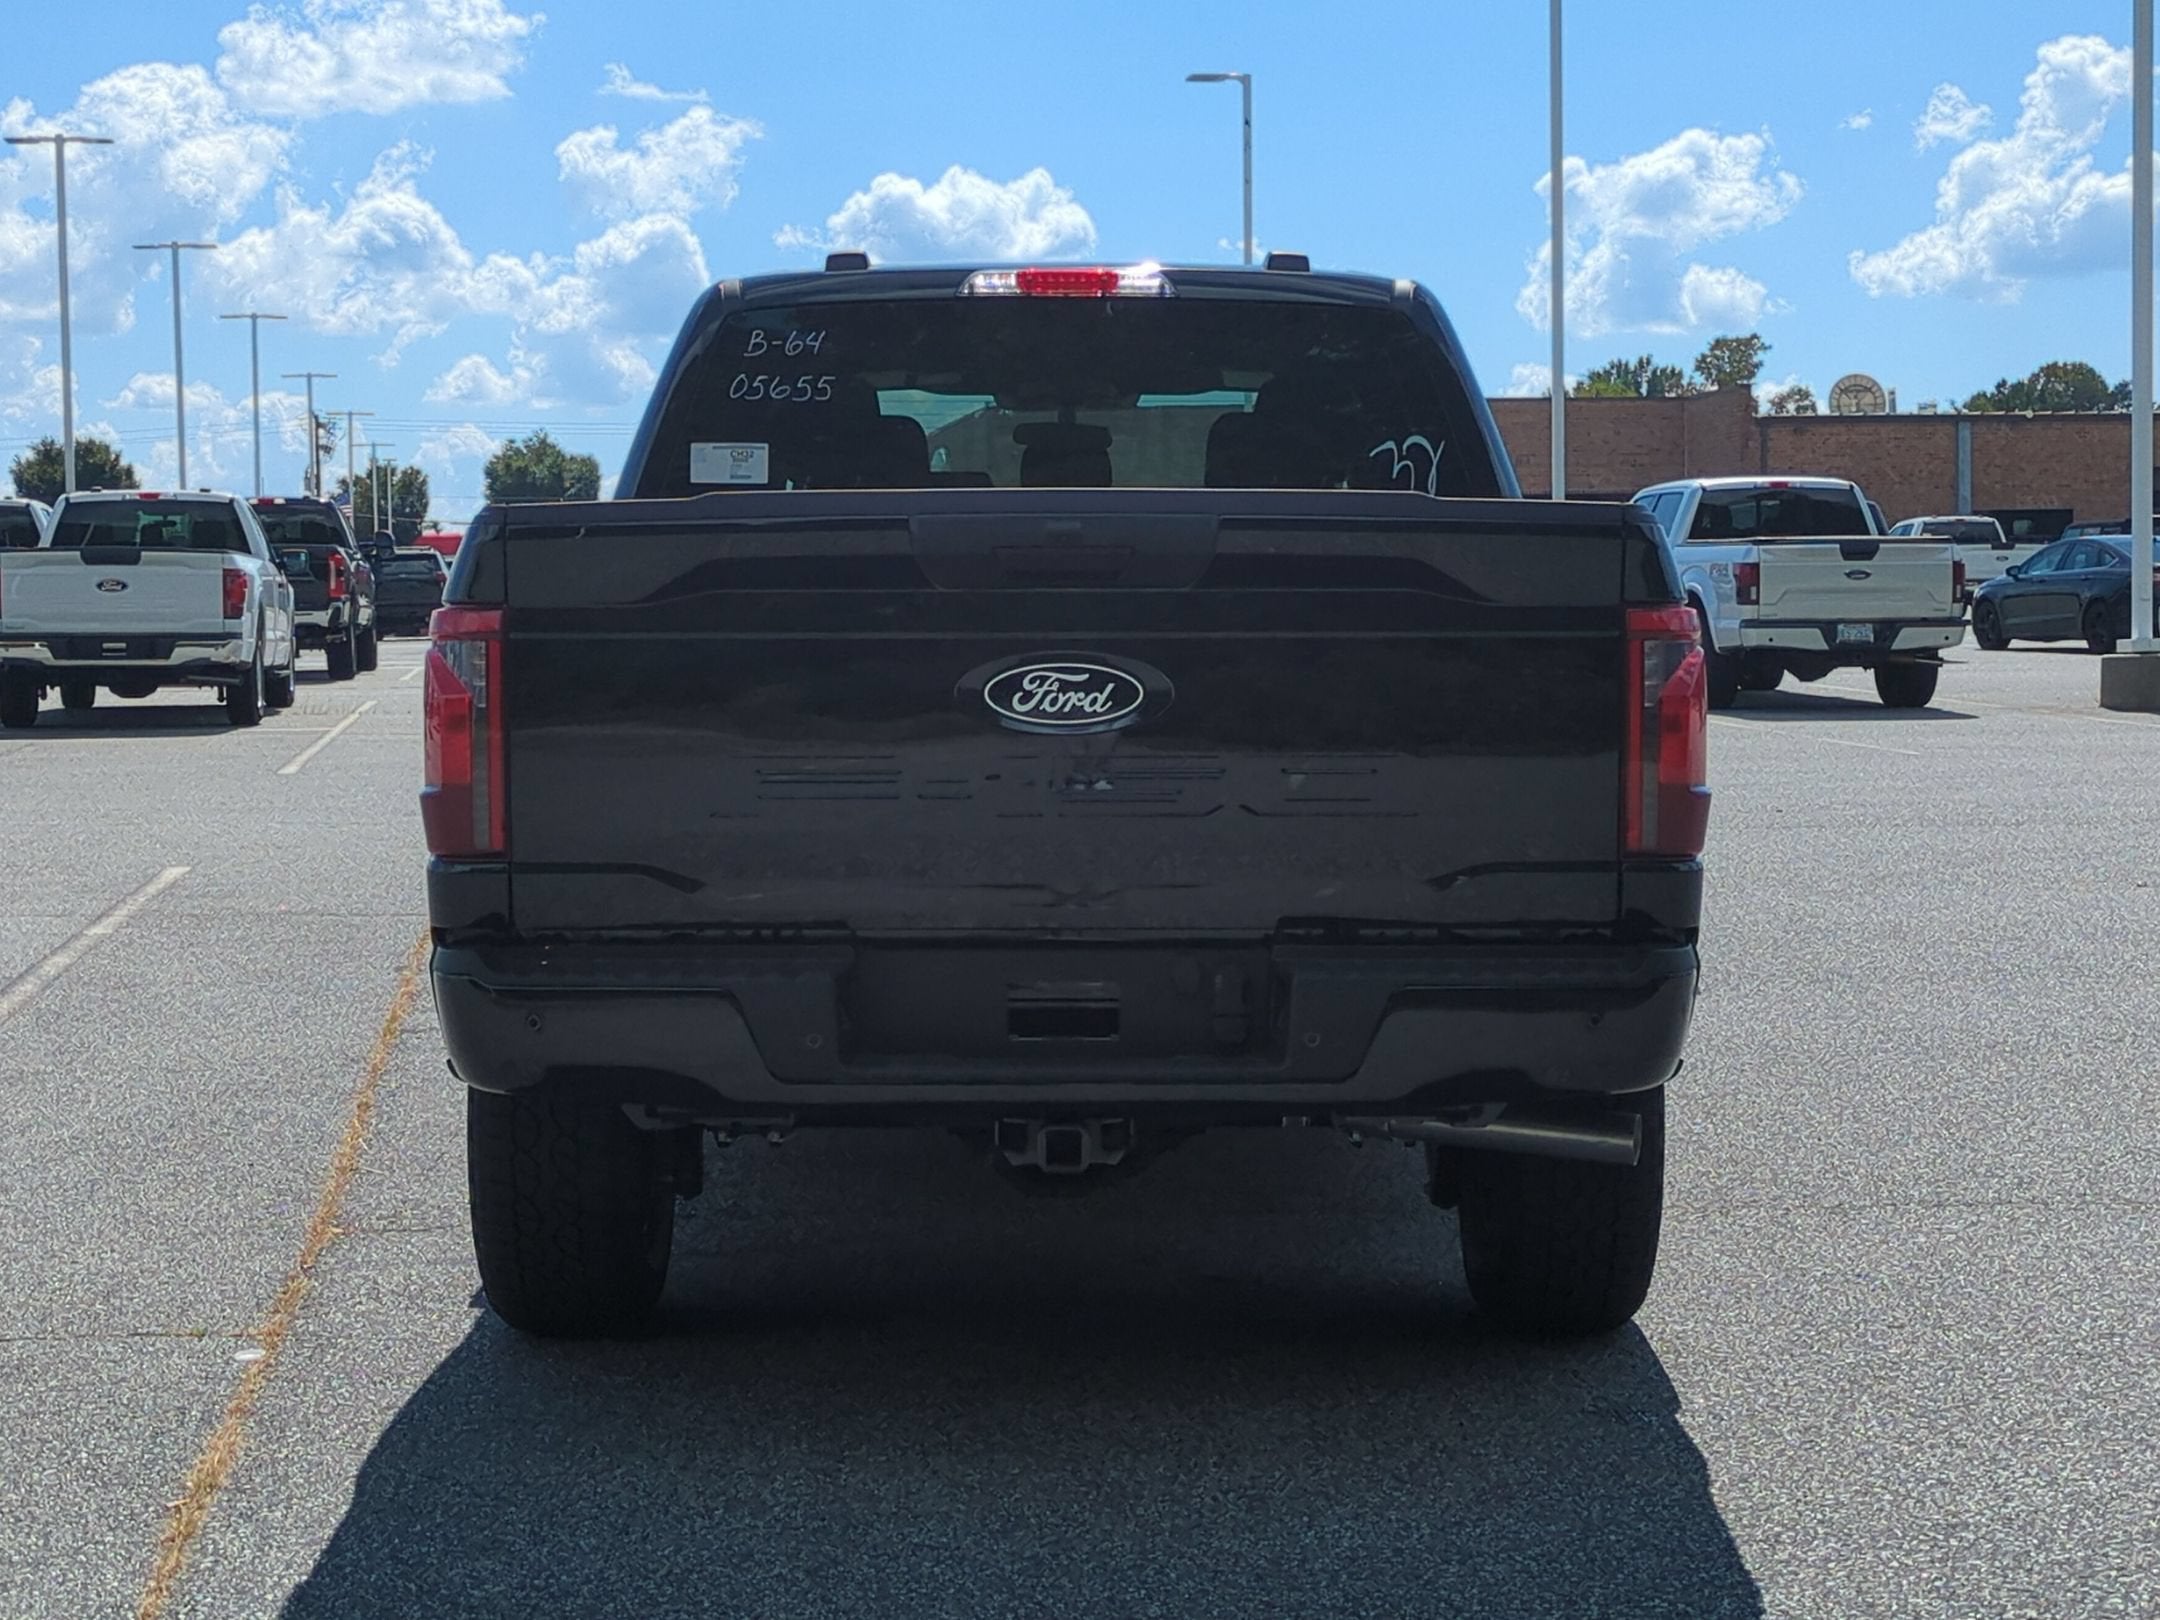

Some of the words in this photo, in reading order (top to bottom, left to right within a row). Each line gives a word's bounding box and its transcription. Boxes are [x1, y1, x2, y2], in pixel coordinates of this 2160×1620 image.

[743, 329, 826, 357] B-64
[729, 373, 836, 401] 05655
[1011, 670, 1116, 714] Ford
